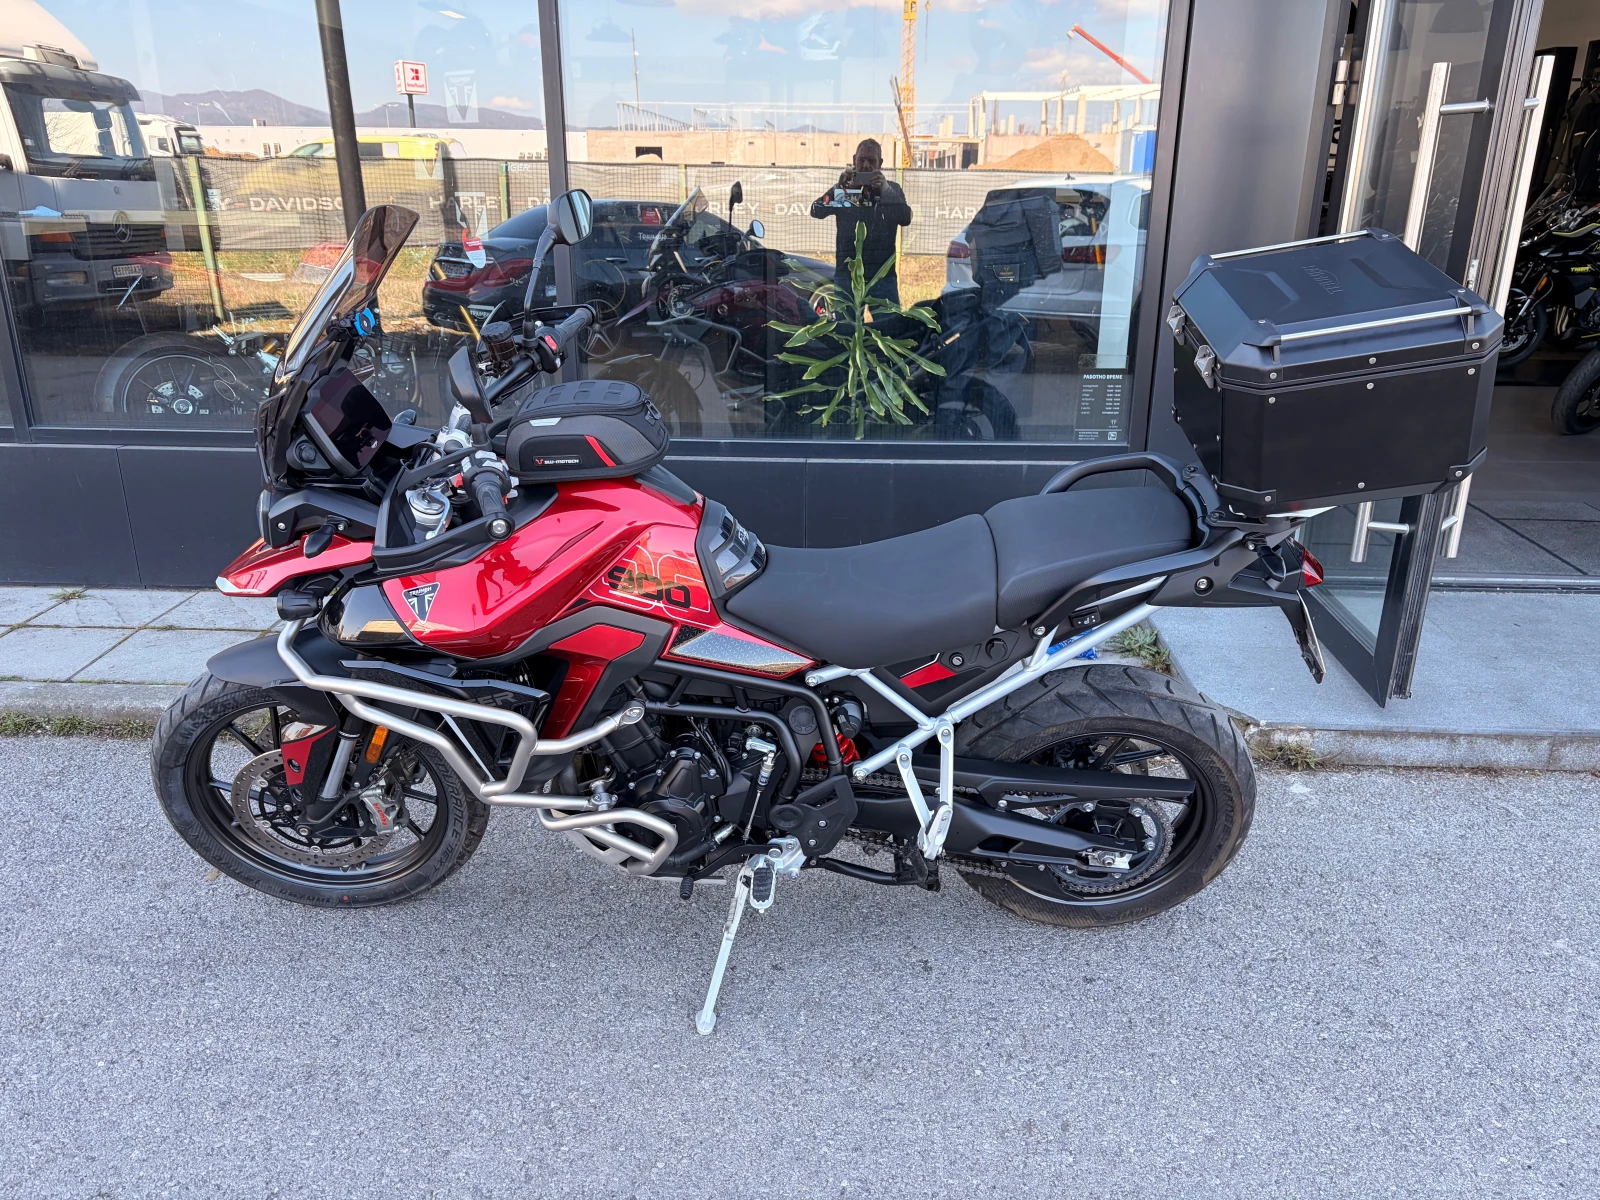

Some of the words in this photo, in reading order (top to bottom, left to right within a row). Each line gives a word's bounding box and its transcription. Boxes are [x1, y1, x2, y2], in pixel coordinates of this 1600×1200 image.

[501, 163, 531, 172] TIGER
[409, 586, 432, 598] TRIUMPH
[607, 565, 691, 609] 900
[373, 802, 388, 827] brembo
